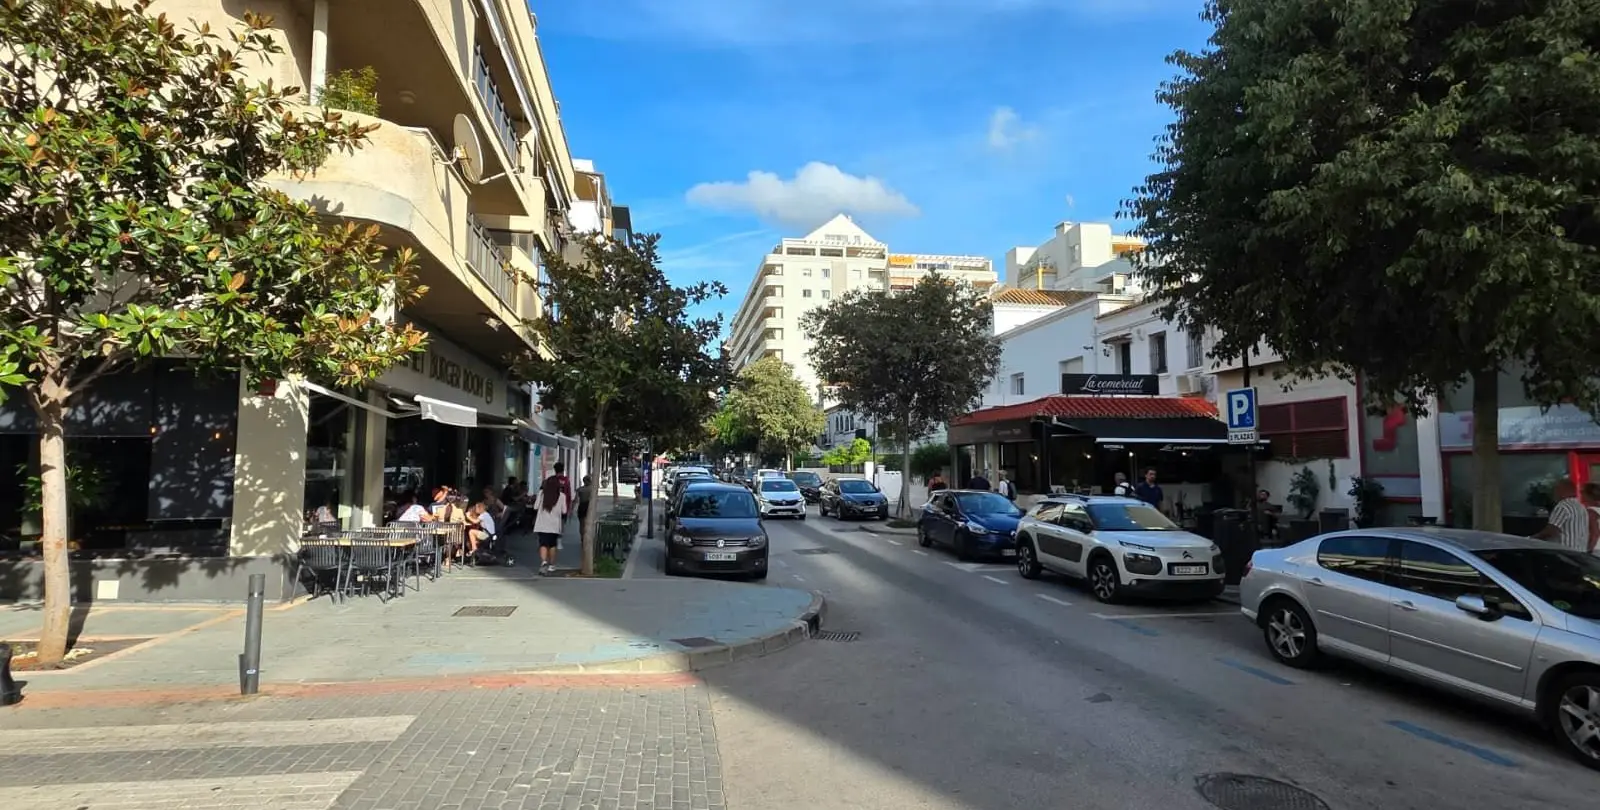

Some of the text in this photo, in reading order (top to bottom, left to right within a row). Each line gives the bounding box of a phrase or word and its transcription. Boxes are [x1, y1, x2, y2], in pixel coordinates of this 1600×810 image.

[430, 354, 461, 389] BURGER
[462, 367, 484, 398] ROOM
[1080, 374, 1101, 392] La
[1097, 379, 1144, 389] comercial
[1232, 393, 1249, 426] P
[1234, 432, 1254, 441] PLAZAS
